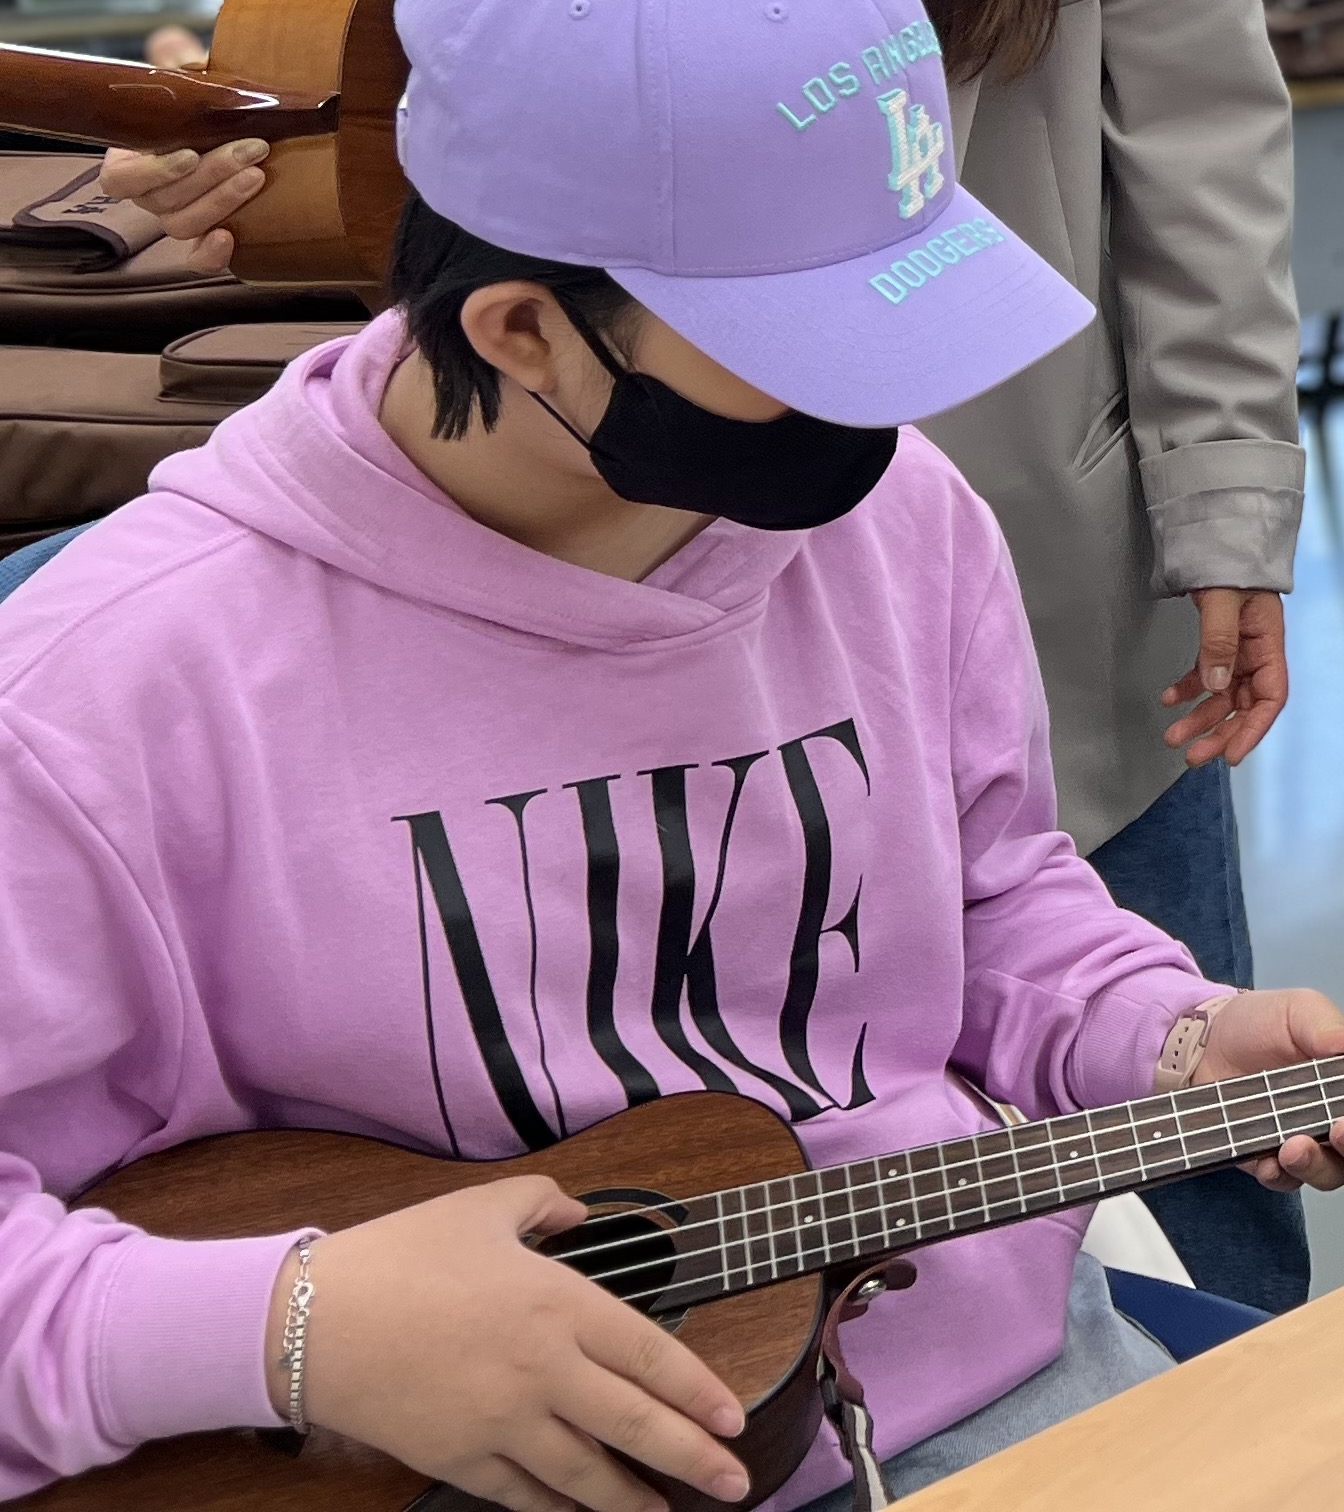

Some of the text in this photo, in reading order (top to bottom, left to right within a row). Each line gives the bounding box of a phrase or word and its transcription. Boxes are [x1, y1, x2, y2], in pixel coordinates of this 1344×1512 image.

[776, 60, 863, 131] LOS
[876, 87, 945, 220] LA
[868, 217, 1007, 306] DODGERS
[390, 717, 877, 1159] NIKE
